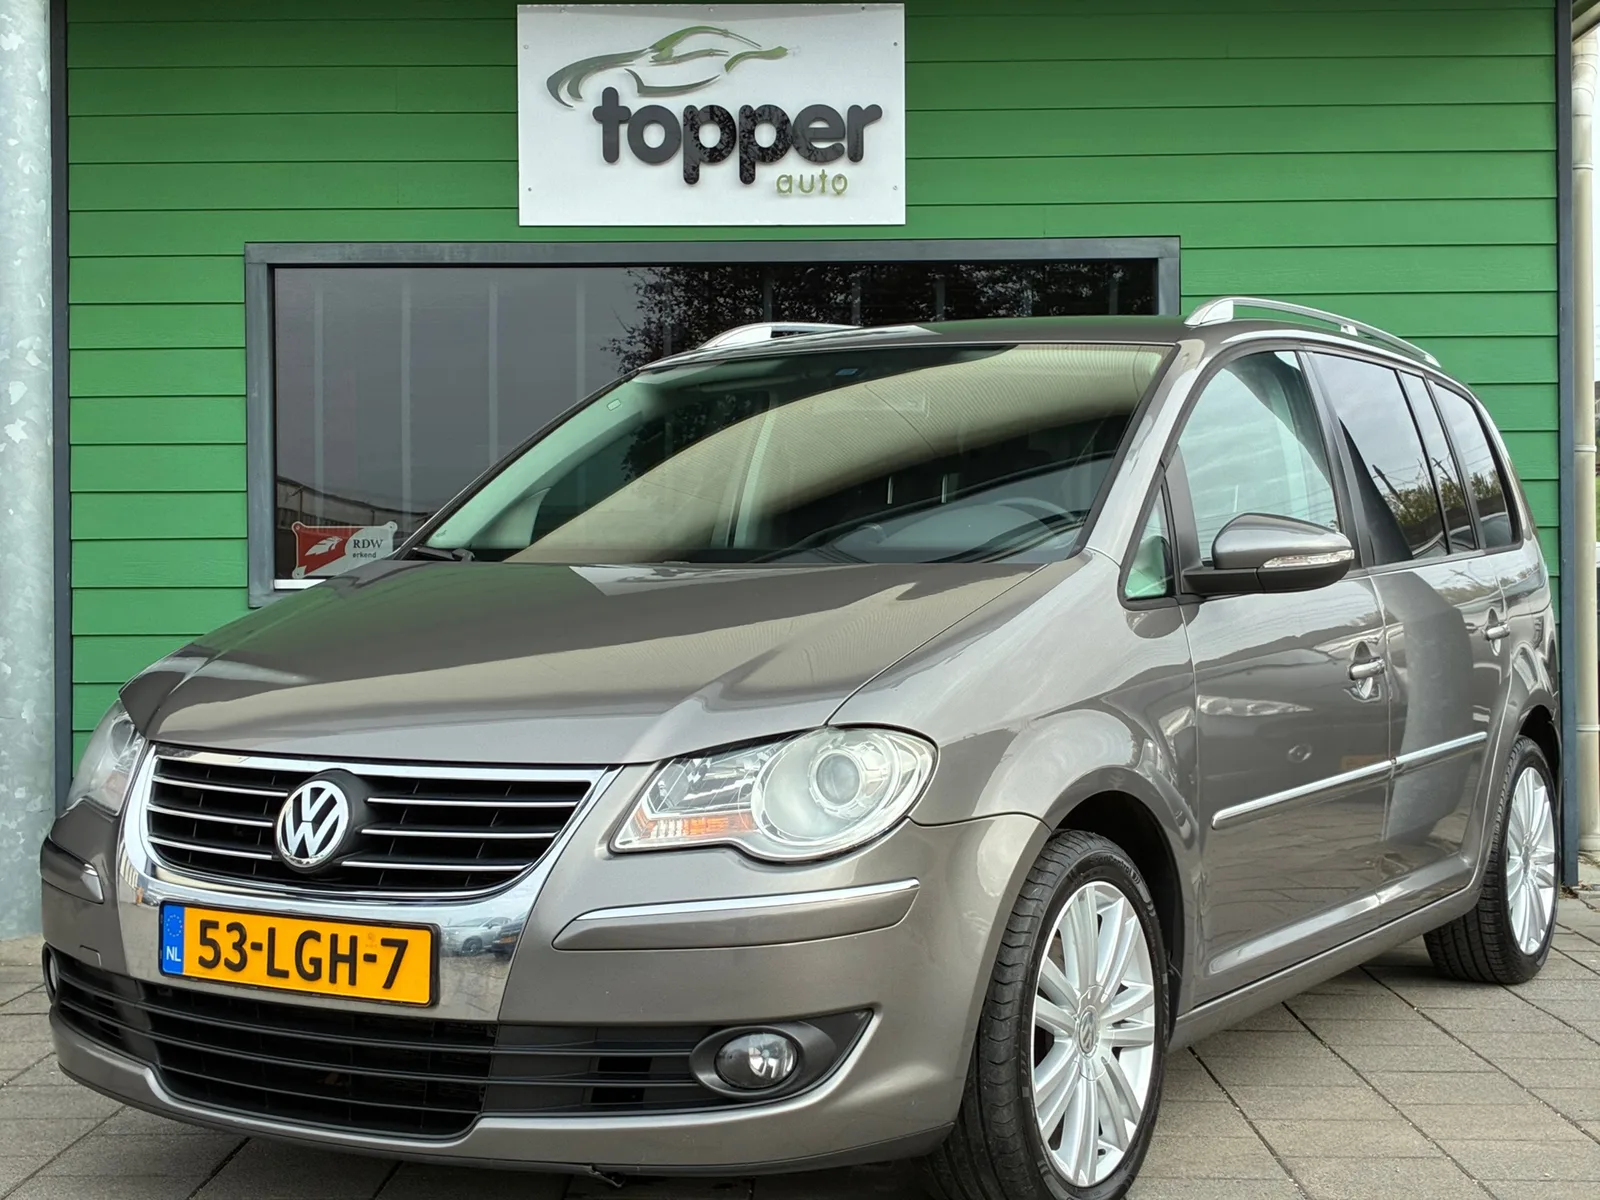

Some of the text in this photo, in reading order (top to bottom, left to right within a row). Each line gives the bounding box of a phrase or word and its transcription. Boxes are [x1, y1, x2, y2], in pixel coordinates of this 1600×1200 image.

[592, 86, 883, 185] topper
[776, 169, 848, 195] auto
[353, 539, 383, 549] RDW
[277, 780, 349, 867] VW
[166, 946, 181, 962] NL
[198, 919, 408, 990] 53-LGH-7
